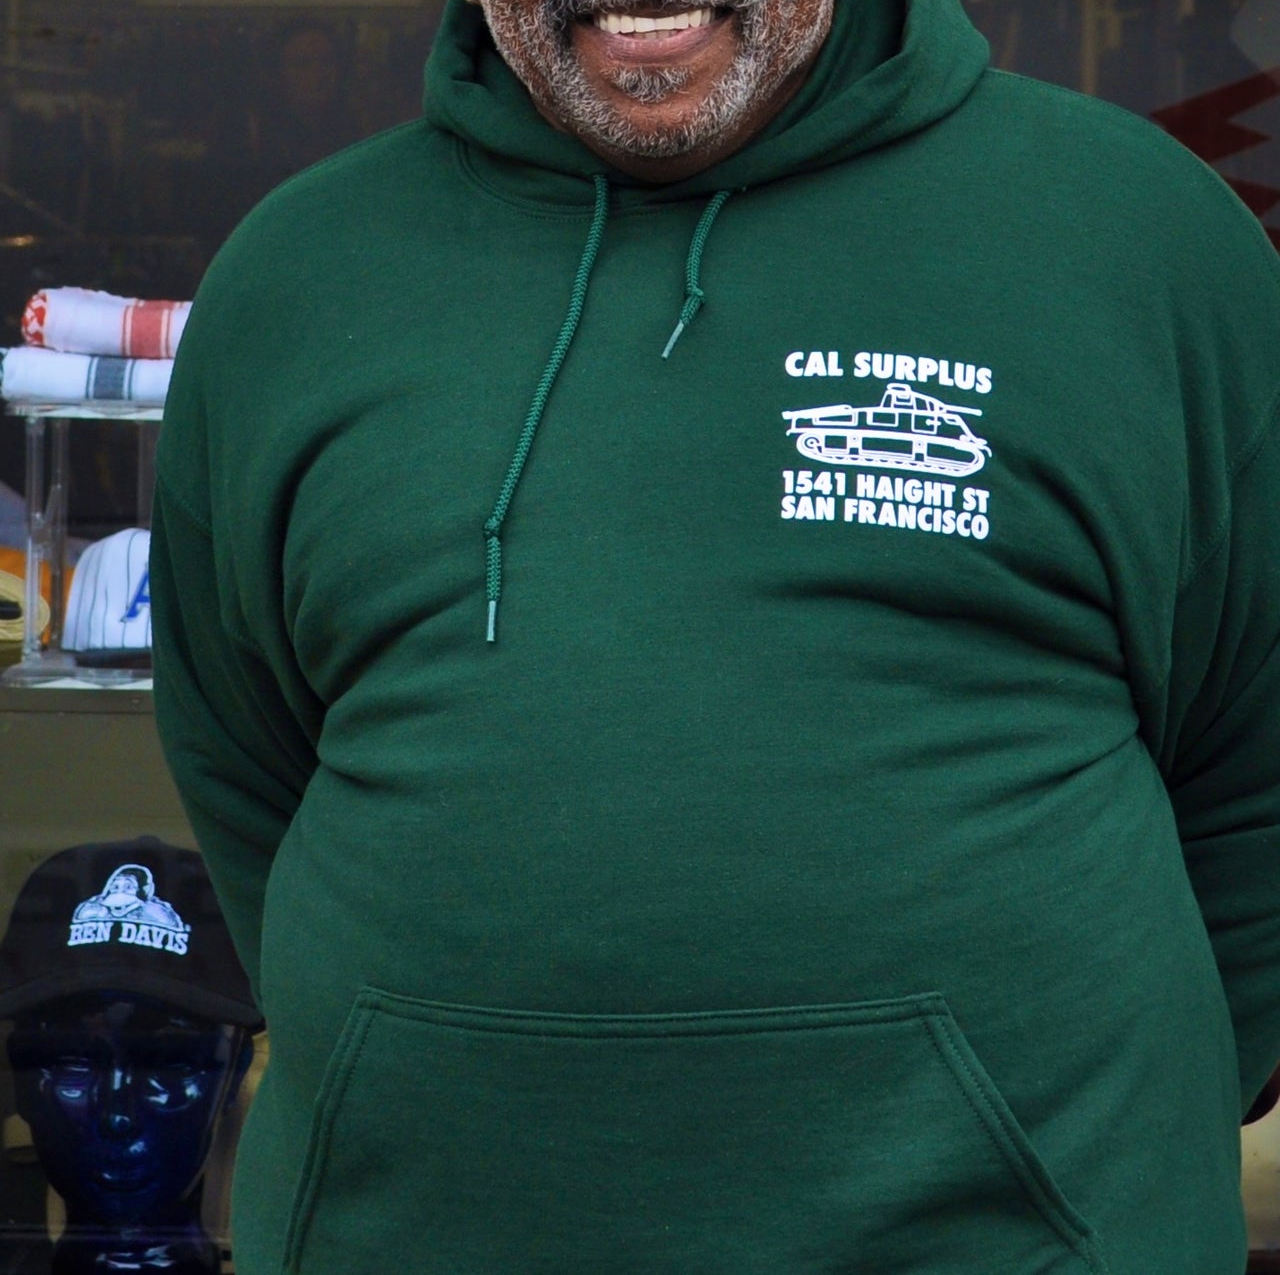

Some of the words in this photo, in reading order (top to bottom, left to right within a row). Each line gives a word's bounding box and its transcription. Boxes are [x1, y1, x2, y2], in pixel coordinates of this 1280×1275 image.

[784, 350, 844, 378] CAL
[853, 352, 993, 394] SURPLUS
[781, 470, 847, 496] 1541
[856, 474, 957, 509] HAIGHT
[962, 488, 991, 514] ST
[780, 495, 836, 522] SAN
[843, 498, 991, 541] FRANCISCO
[67, 922, 114, 947] BEN
[118, 923, 190, 956] DAVIS
